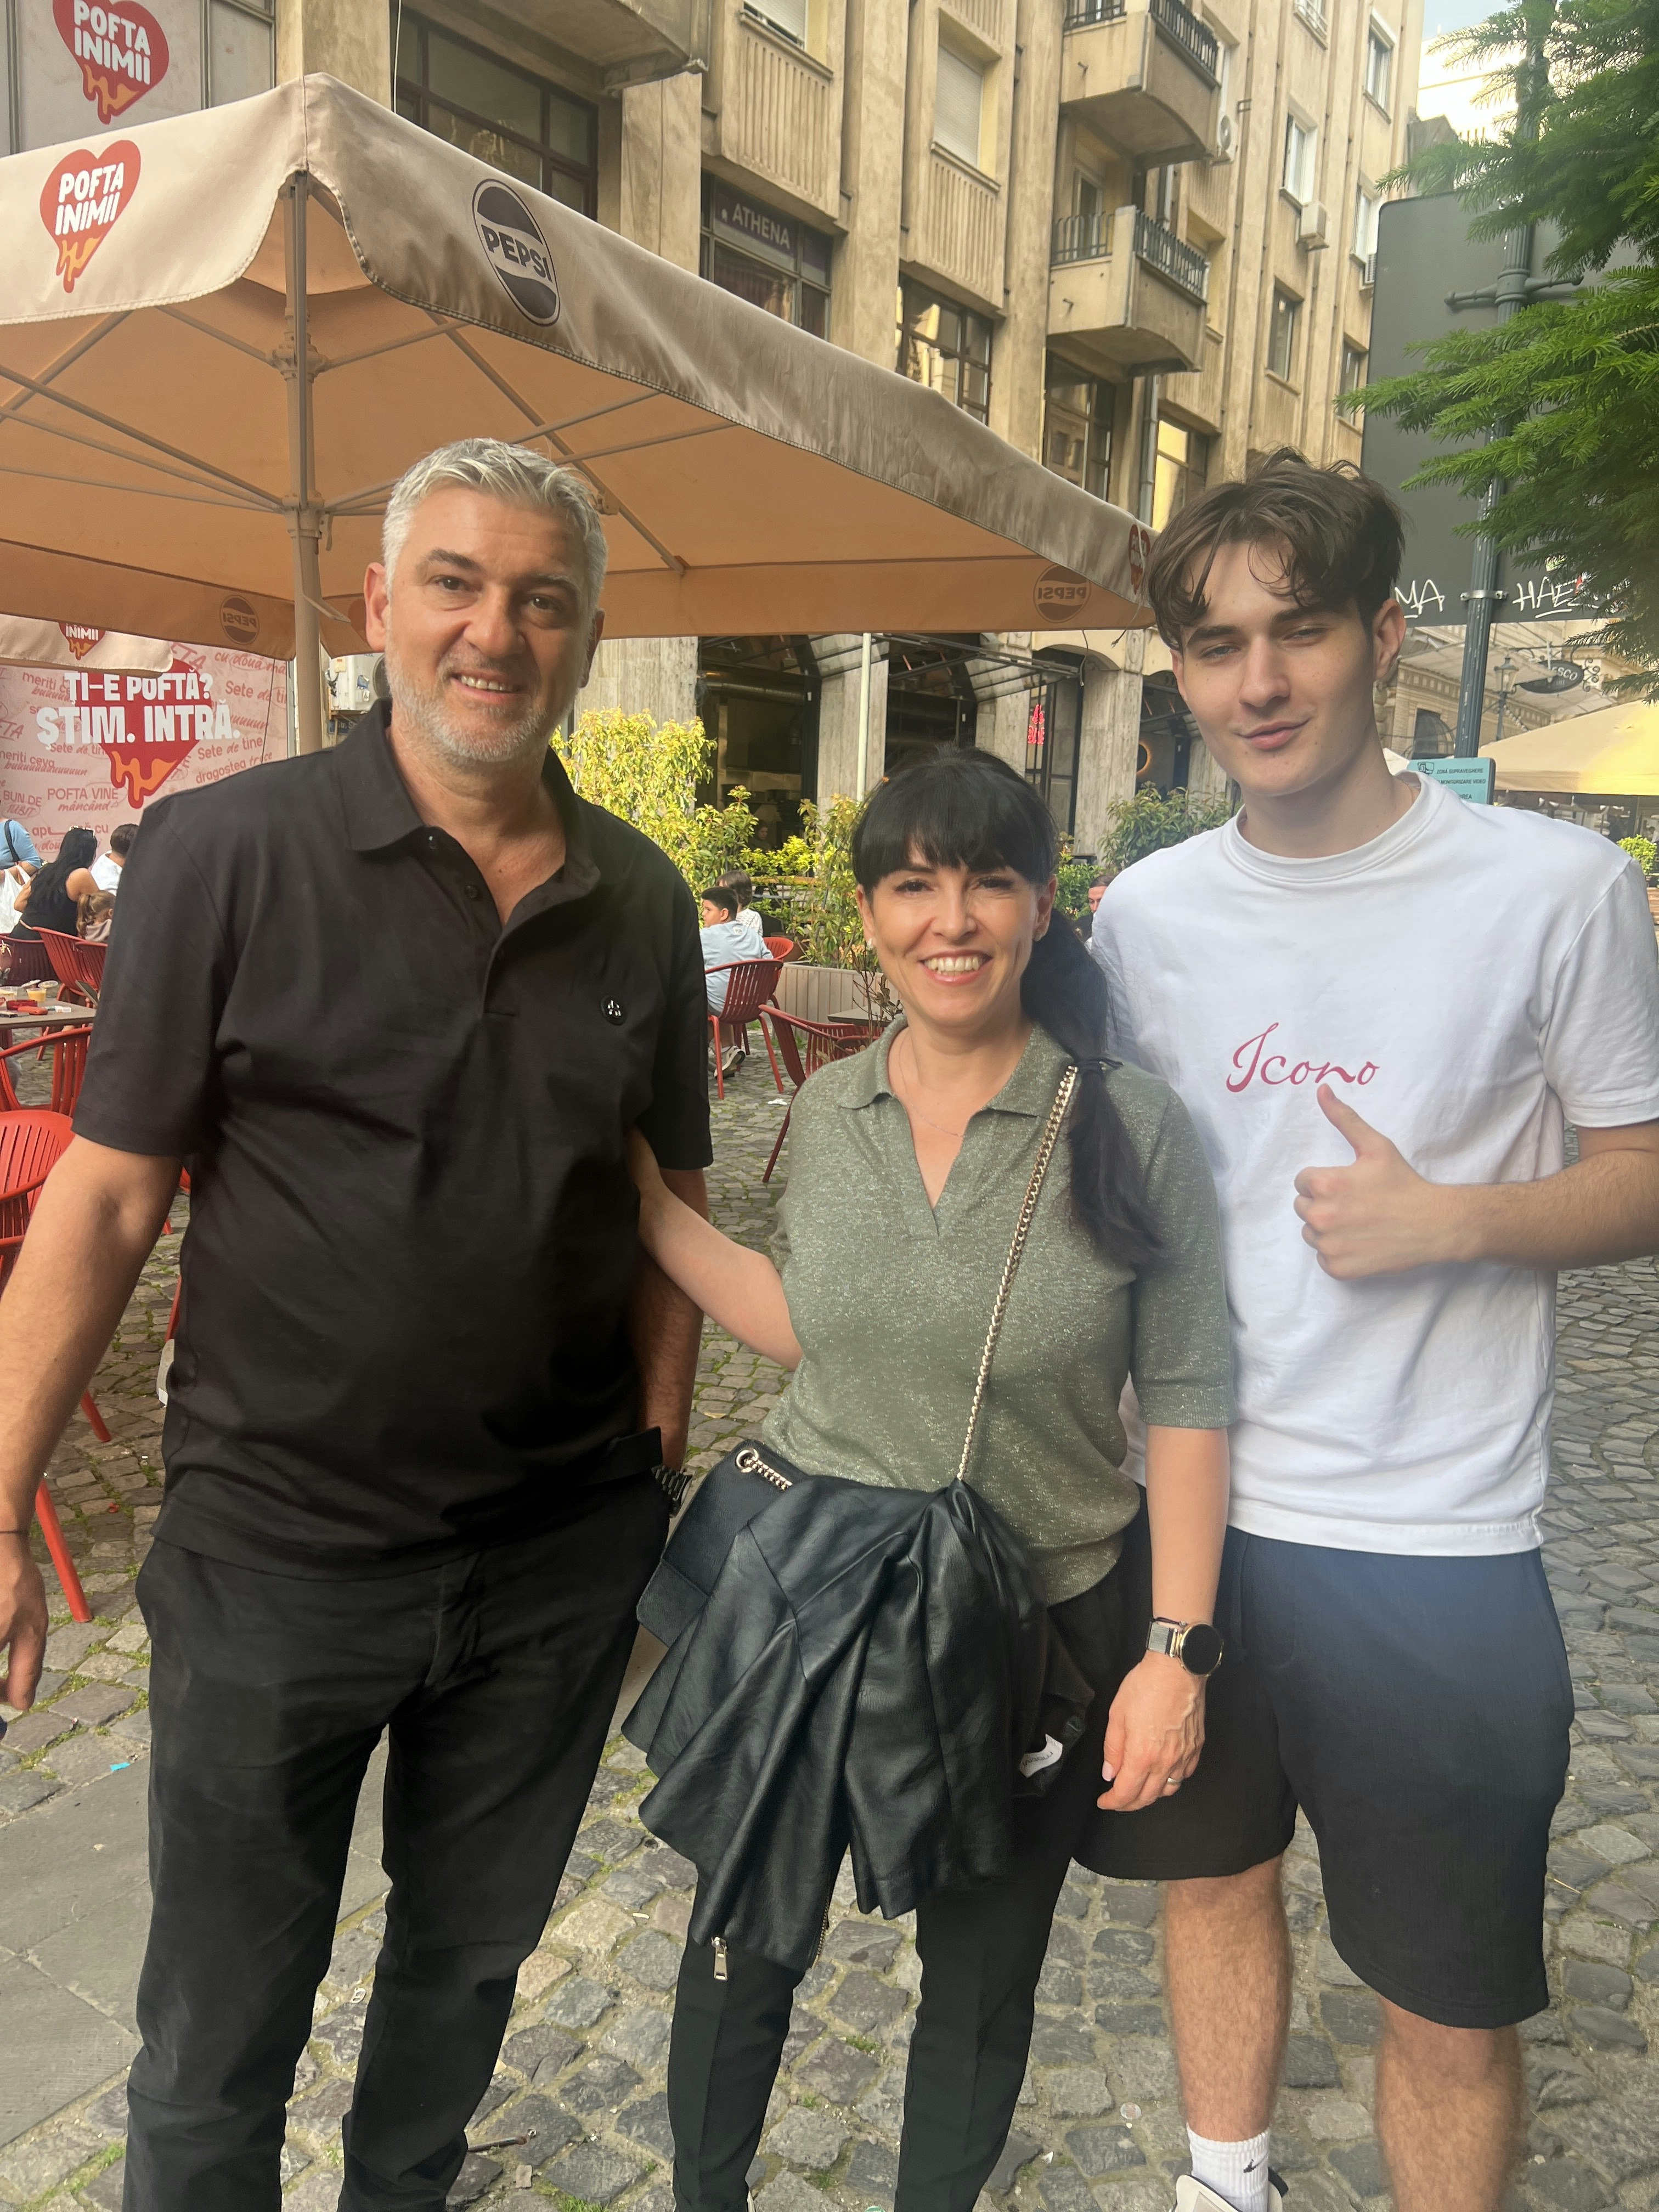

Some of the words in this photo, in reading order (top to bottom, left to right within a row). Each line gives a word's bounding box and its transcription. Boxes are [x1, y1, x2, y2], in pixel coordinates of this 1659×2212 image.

[74, 0, 151, 56] POFTA
[74, 27, 150, 85] INIMII
[58, 162, 124, 203] POFTA
[55, 191, 120, 236] INIMII
[732, 203, 791, 250] ATHENA
[481, 224, 553, 283] PEPSI
[66, 625, 99, 641] INIMII
[127, 668, 213, 701] POFTĂ?
[225, 680, 253, 698] Sete
[144, 698, 241, 742] INTRĂ.
[198, 744, 223, 760] Sete
[242, 737, 263, 750] tine
[195, 760, 246, 784] dragostea
[3, 789, 25, 803] BUN
[28, 795, 42, 807] DE
[47, 788, 88, 800] POFTA
[92, 788, 119, 800] VINE
[58, 800, 110, 812] mâncând
[1226, 1022, 1380, 1093] Icono
